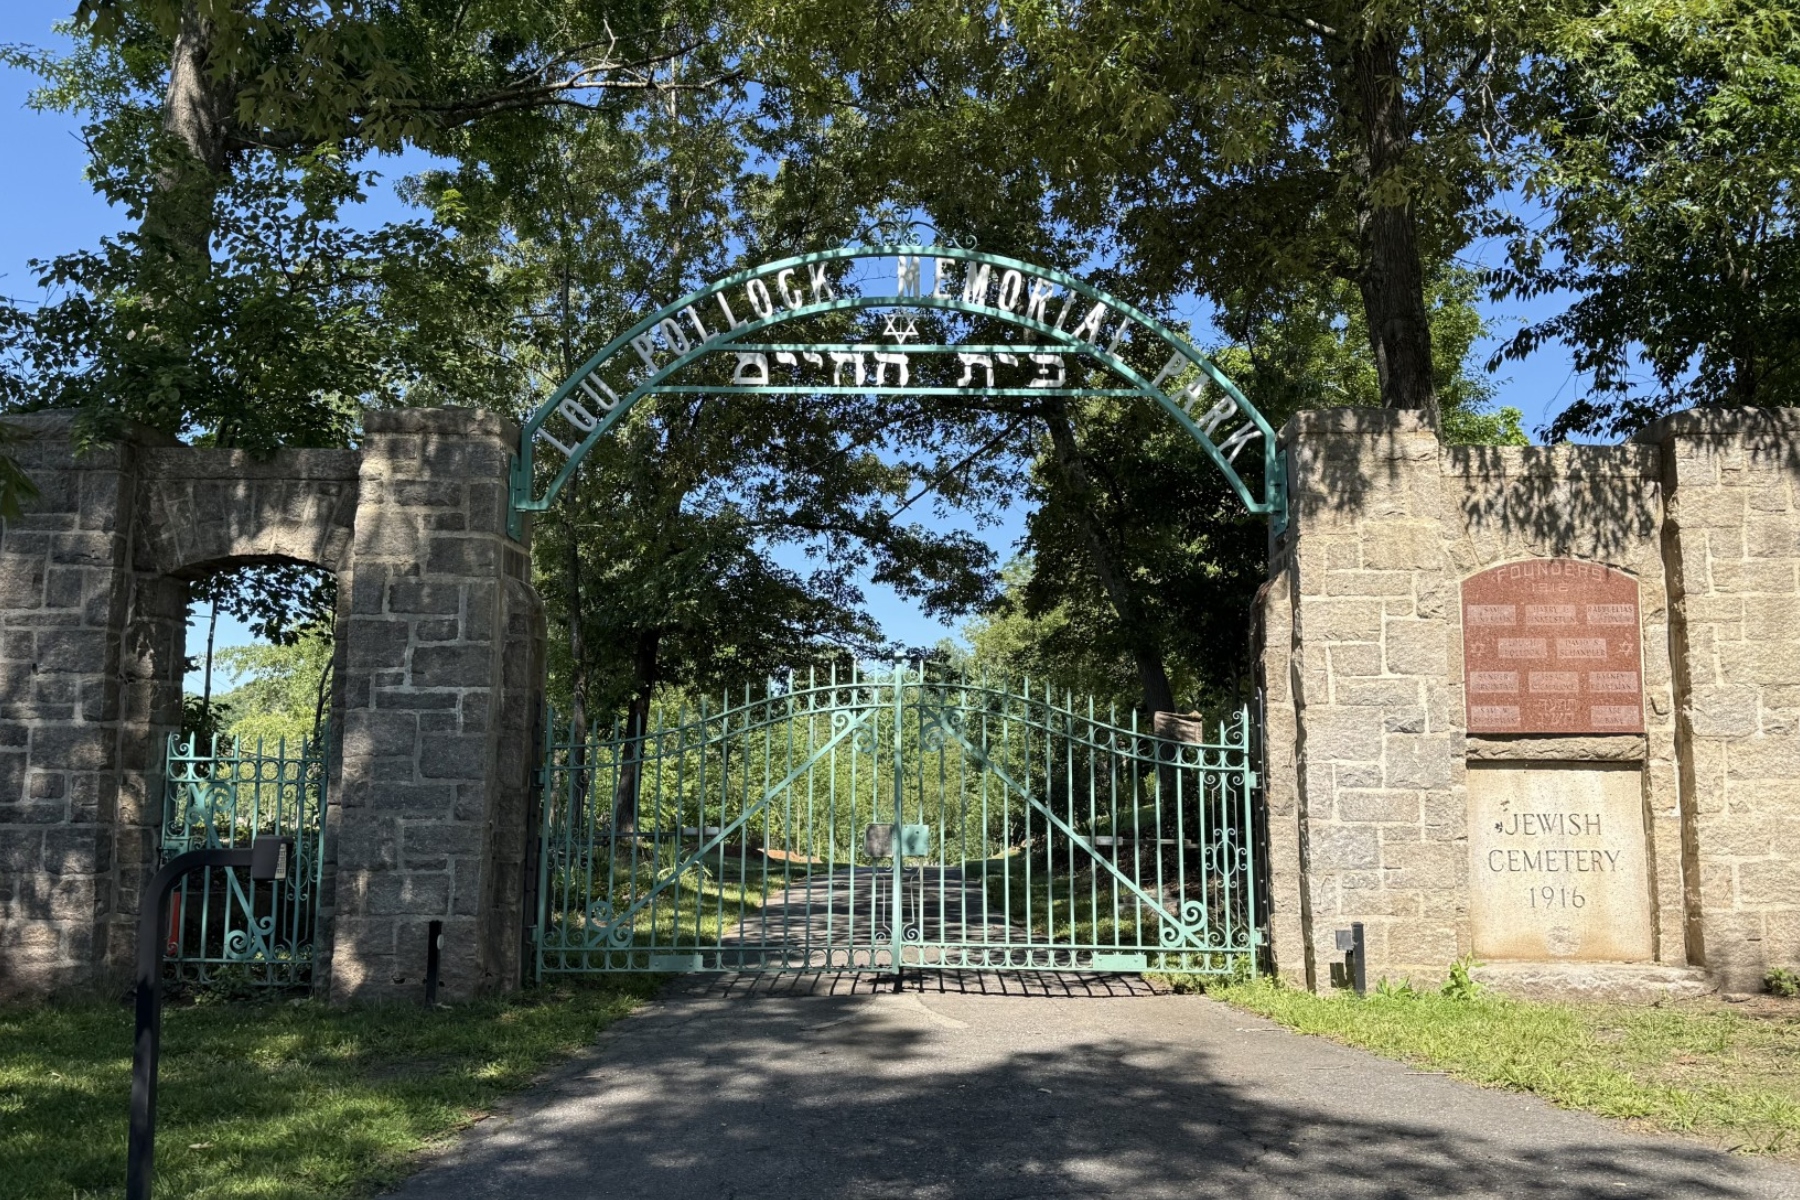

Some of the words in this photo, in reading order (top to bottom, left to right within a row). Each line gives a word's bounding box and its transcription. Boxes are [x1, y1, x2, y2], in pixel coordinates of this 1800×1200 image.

[537, 371, 620, 457] LOU
[631, 261, 835, 375] POLLOCK
[897, 255, 1134, 363] MEMORIAL
[1151, 350, 1263, 464] PARK
[733, 351, 909, 386] החיים
[1496, 562, 1602, 583] FOUNDERS
[1504, 813, 1602, 836] JEWISH
[1488, 849, 1621, 873] CEMETERY
[1529, 886, 1586, 909] 1916
